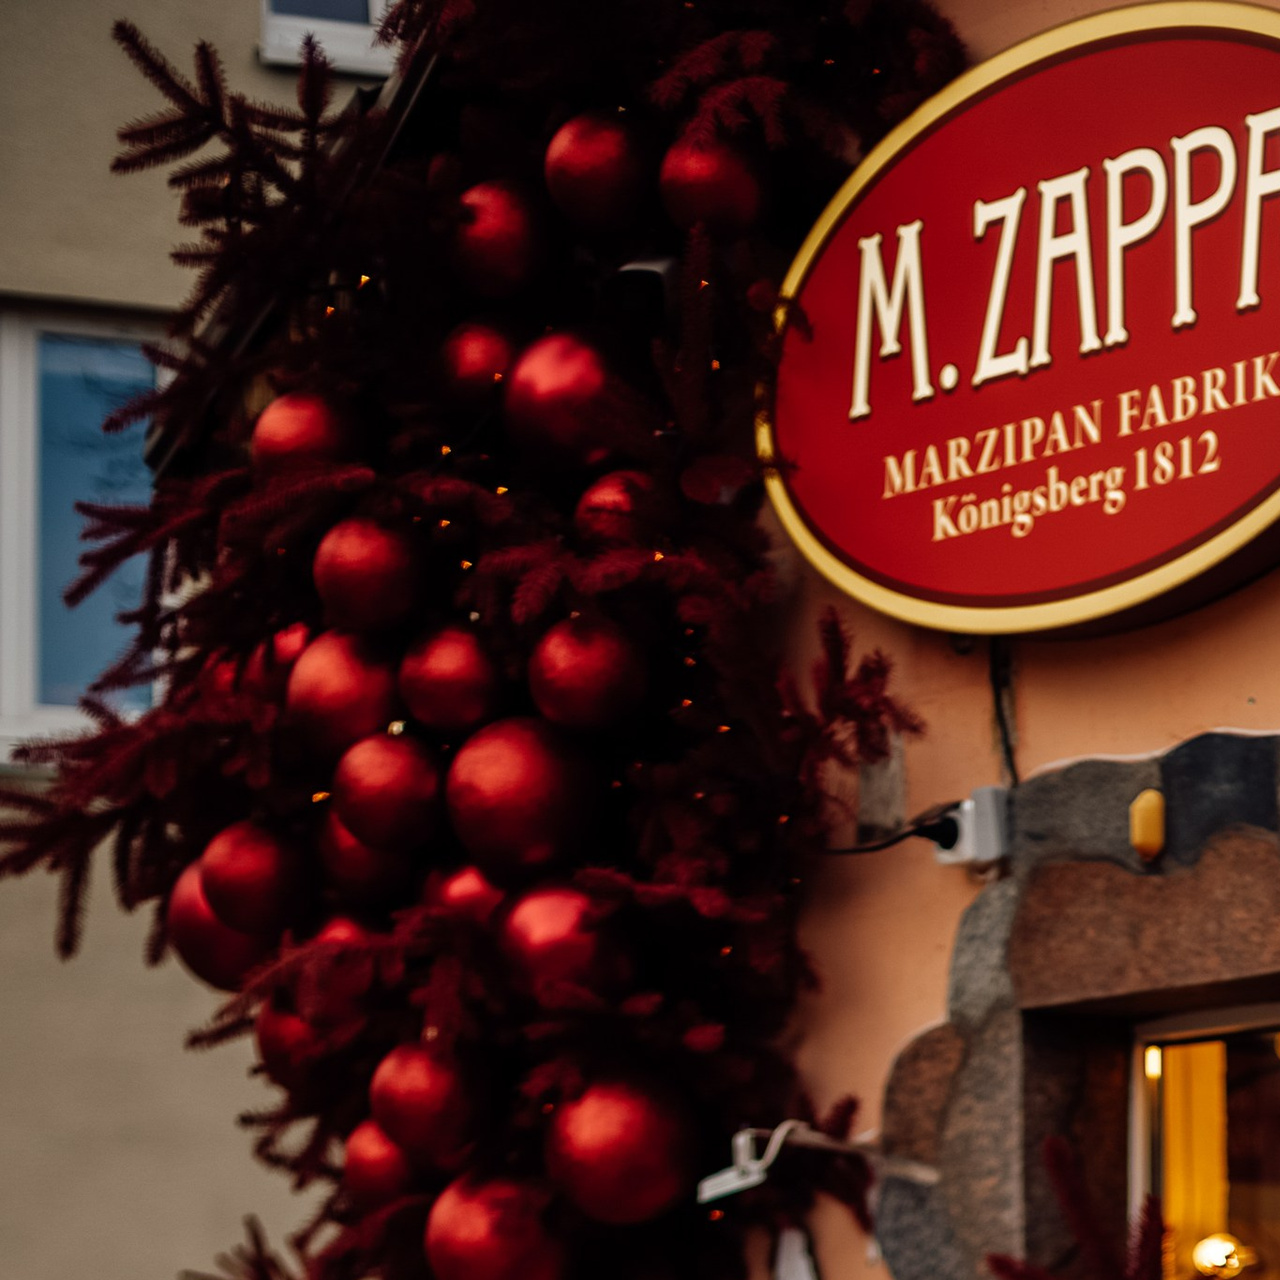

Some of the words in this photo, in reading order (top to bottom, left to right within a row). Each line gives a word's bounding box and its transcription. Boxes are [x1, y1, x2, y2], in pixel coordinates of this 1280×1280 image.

[849, 218, 959, 420] M.
[882, 400, 1103, 499] MARZIPAN
[931, 465, 1127, 543] Königsberg
[1133, 429, 1222, 490] 1812
